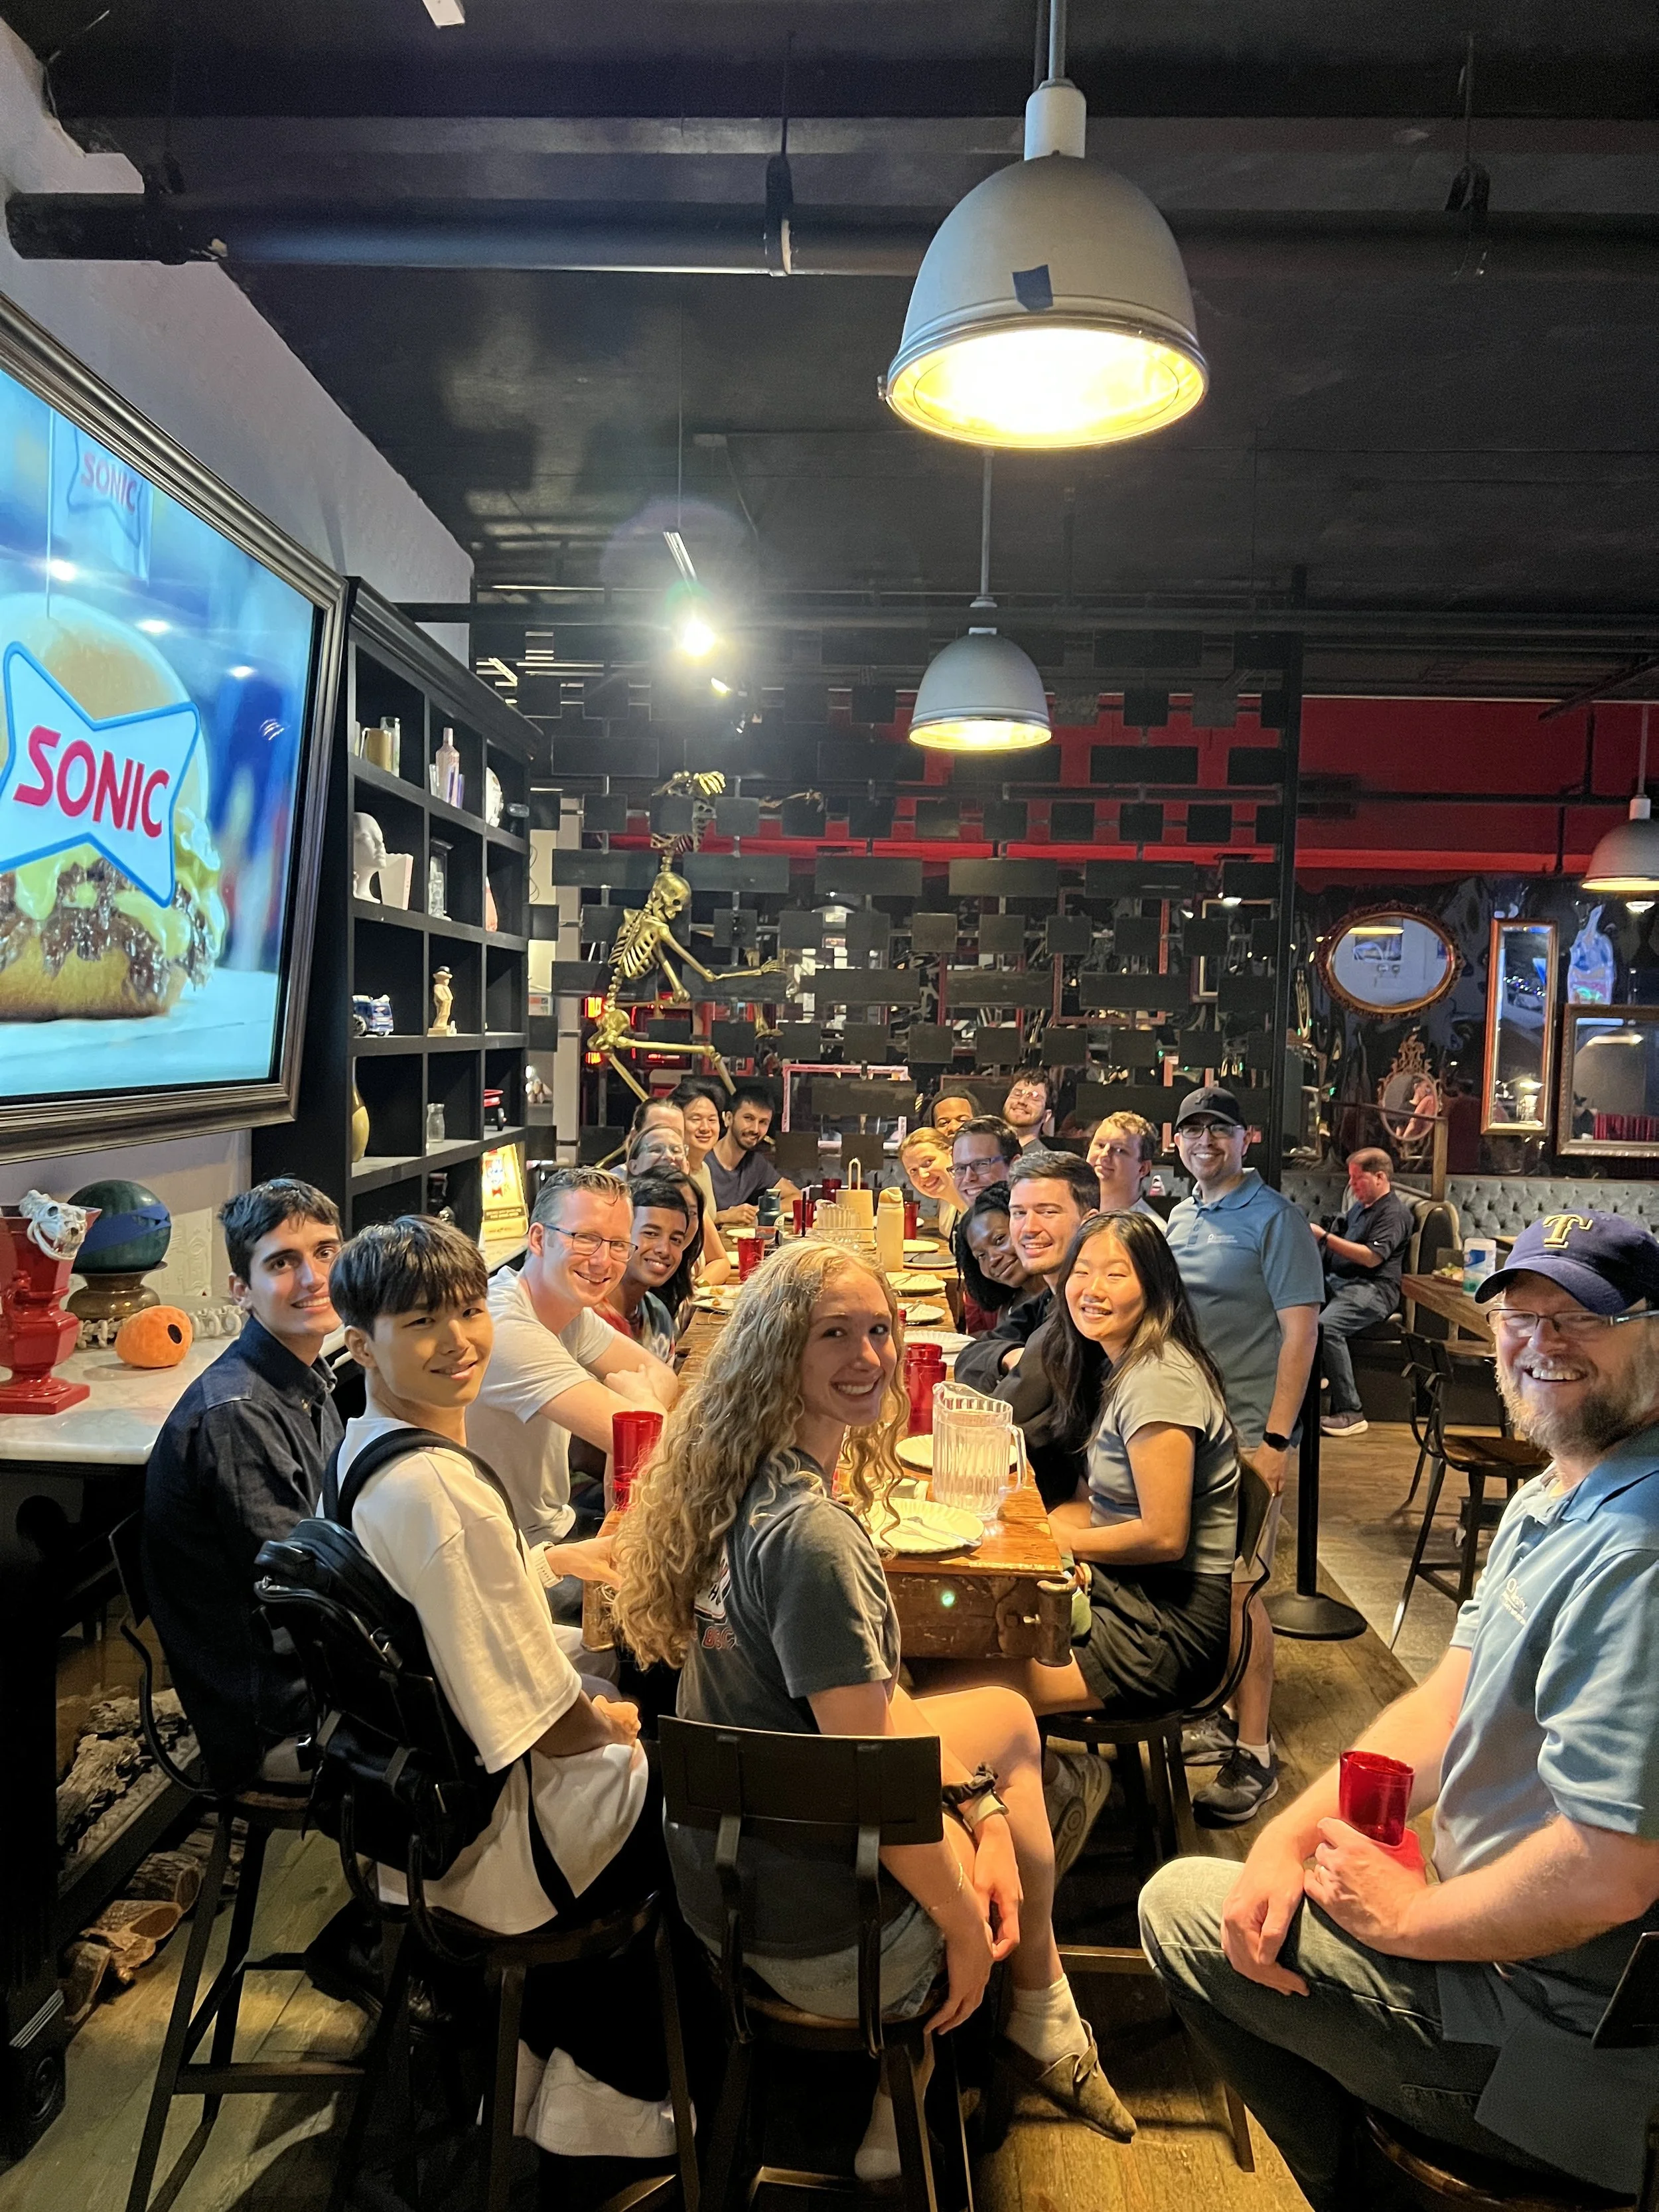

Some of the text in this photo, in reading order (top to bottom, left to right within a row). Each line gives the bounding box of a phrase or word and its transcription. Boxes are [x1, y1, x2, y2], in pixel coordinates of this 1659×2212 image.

[81, 453, 137, 514] SONIC
[13, 725, 170, 838] SONIC
[1543, 1214, 1593, 1248] T
